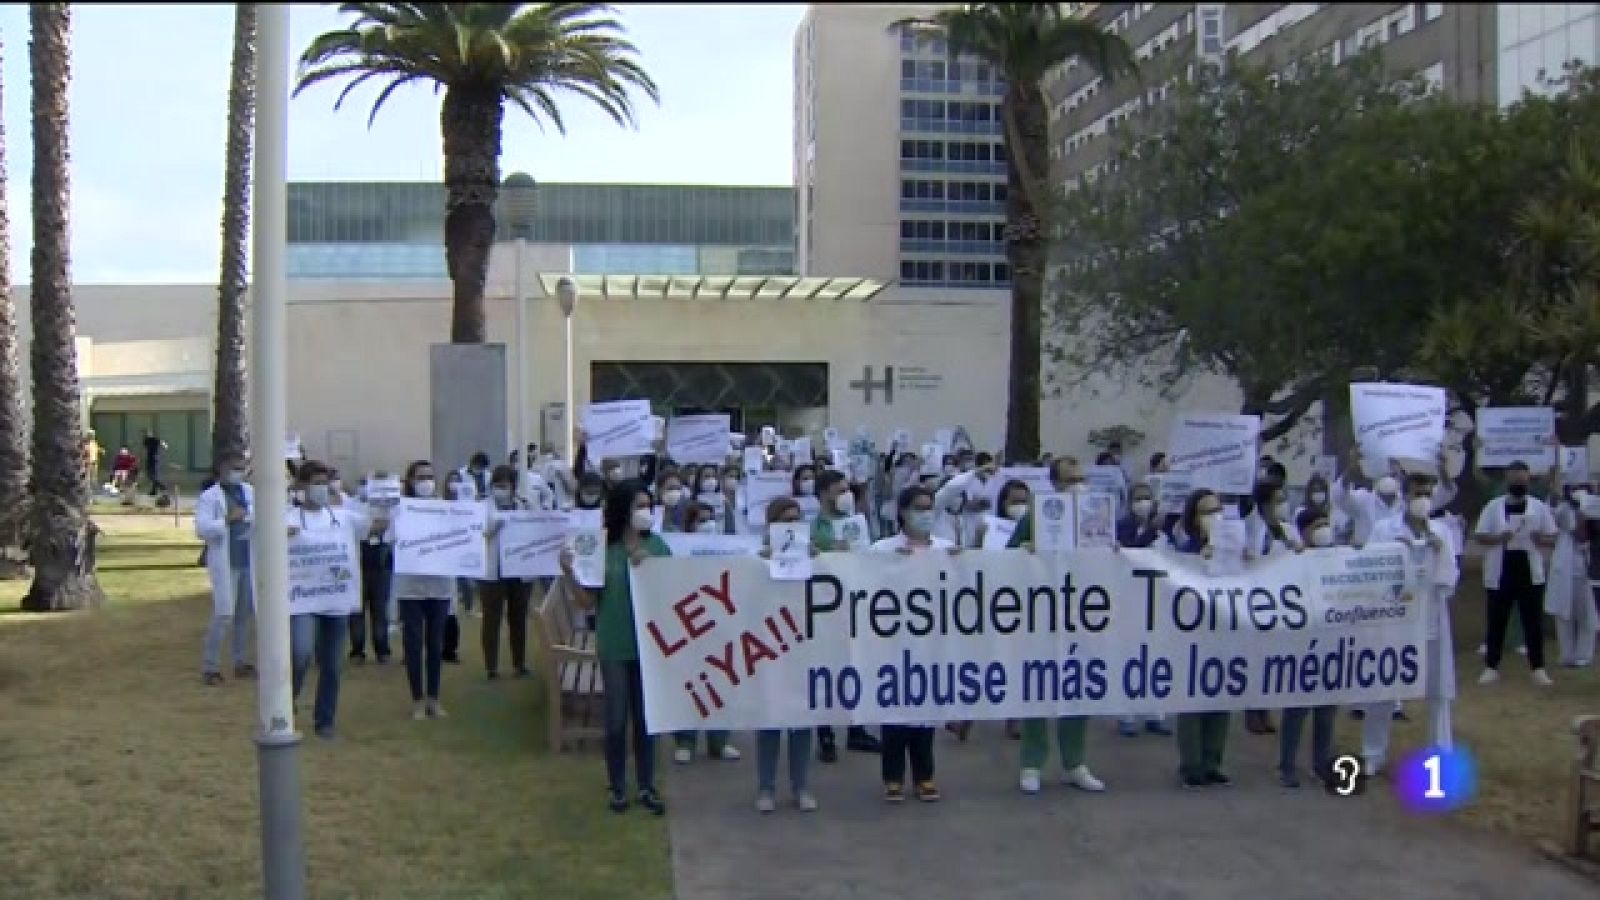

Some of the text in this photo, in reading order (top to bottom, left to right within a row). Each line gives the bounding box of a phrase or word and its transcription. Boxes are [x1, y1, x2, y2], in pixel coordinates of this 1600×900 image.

[647, 570, 736, 658] LEY
[804, 569, 1307, 639] Presidente Torres
[808, 637, 1418, 711] no abuse más de los médicos
